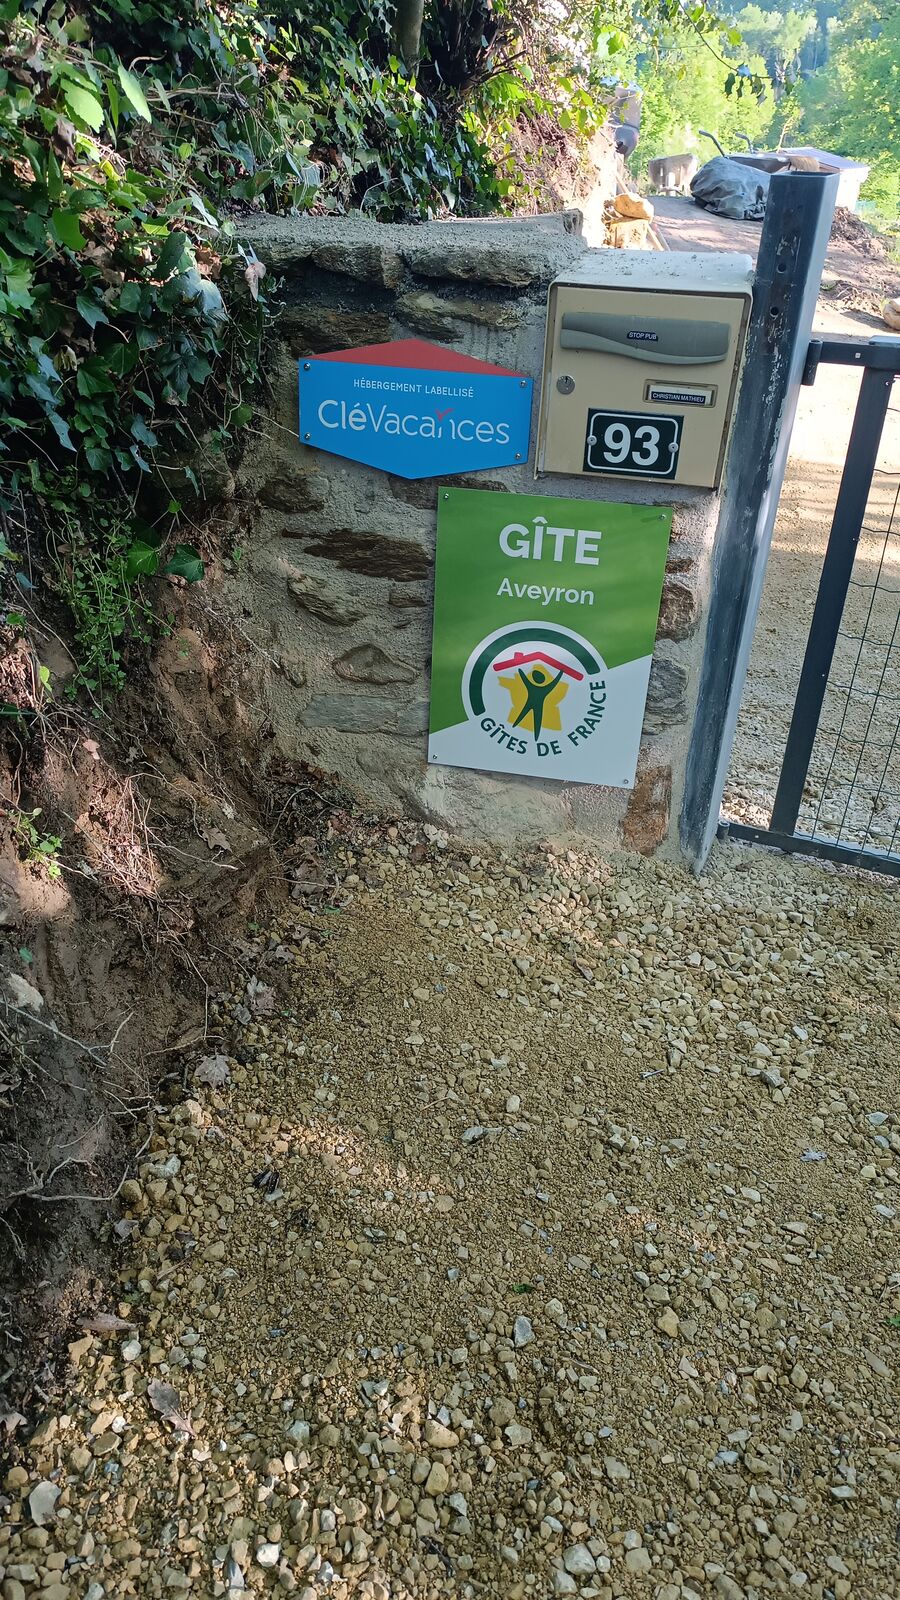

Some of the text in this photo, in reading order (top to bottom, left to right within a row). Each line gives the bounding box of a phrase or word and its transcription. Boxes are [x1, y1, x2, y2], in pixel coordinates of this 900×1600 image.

[354, 377, 474, 398] HÉBERGEMENT LABELLISÉ
[652, 392, 705, 403] CHRISTIAN MATHIEU
[603, 422, 660, 466] 93
[499, 516, 602, 566] GÎTE
[496, 577, 594, 606] Aveyron
[480, 680, 607, 757] GÎTES DE FRANCE
